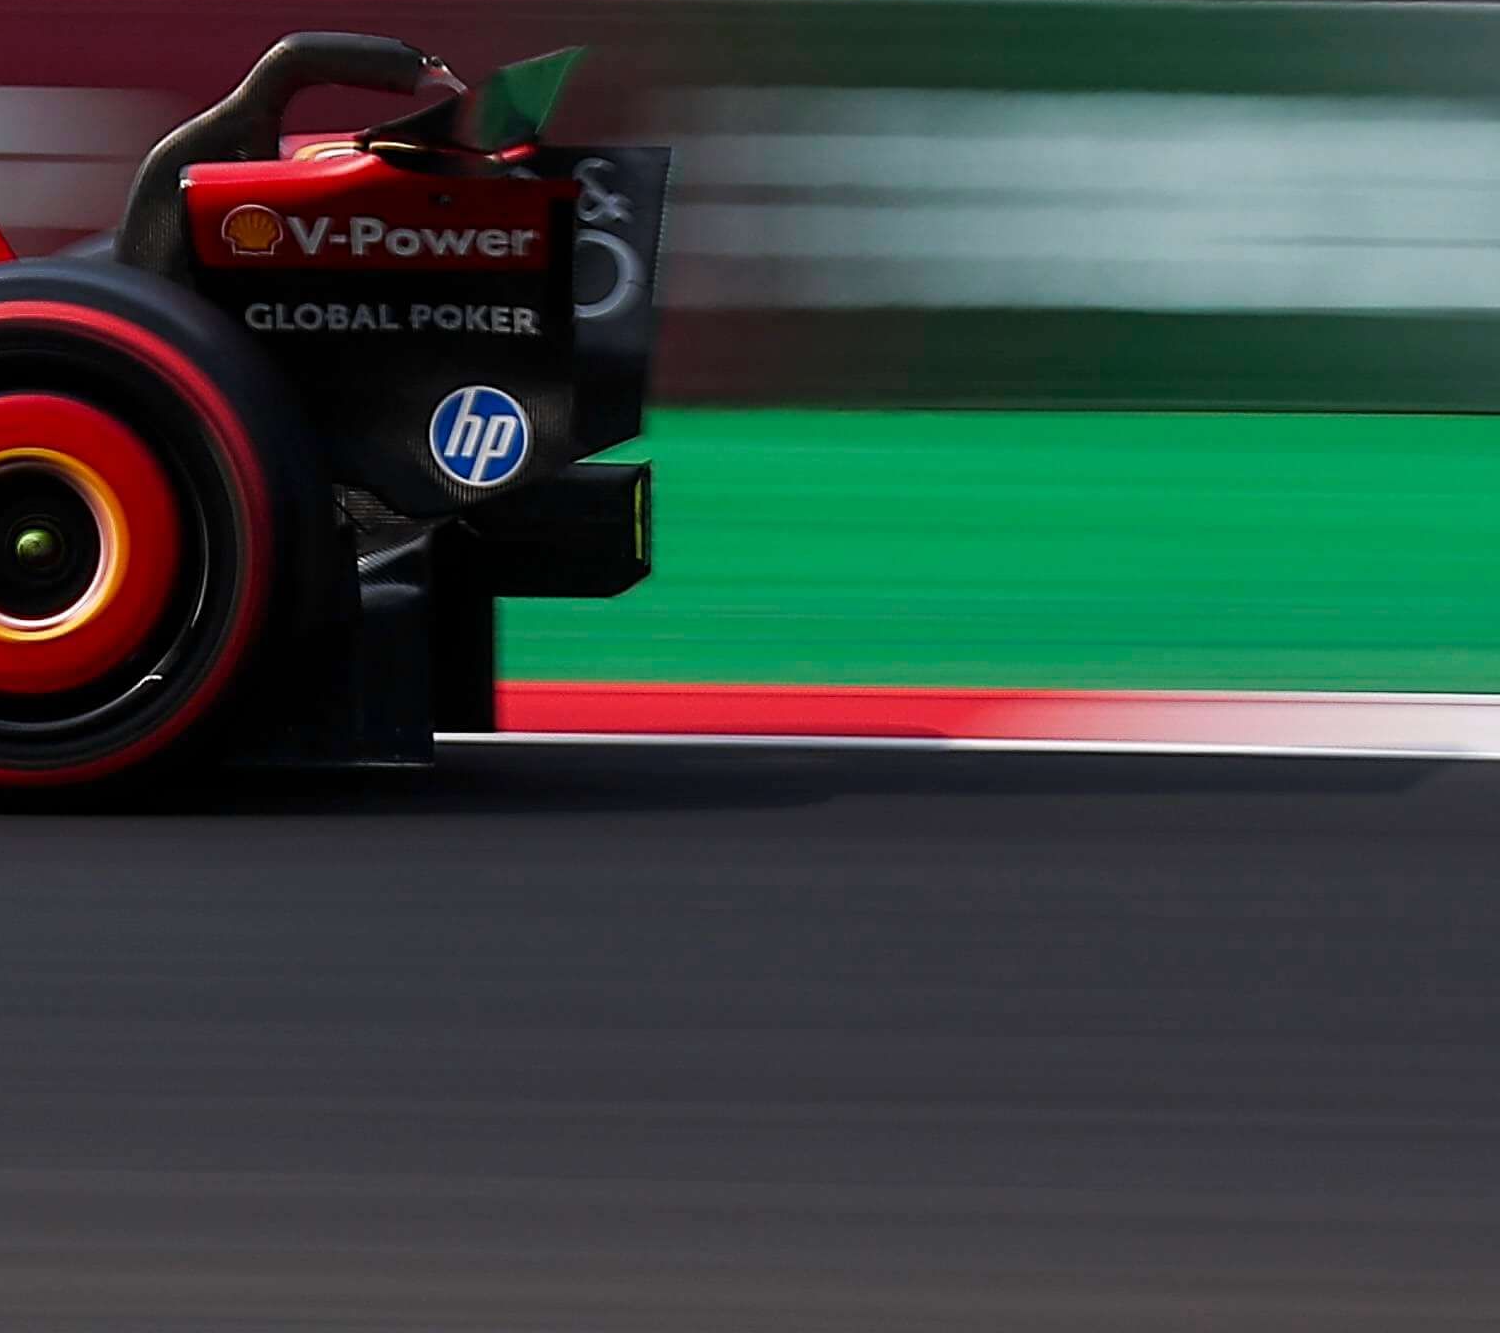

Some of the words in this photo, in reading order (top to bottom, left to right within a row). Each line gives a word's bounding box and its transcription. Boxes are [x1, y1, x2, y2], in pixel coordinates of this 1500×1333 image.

[287, 215, 538, 257] V-Power
[244, 301, 399, 332] GLOBAL
[409, 303, 541, 336] POKER
[443, 387, 518, 484] hp
